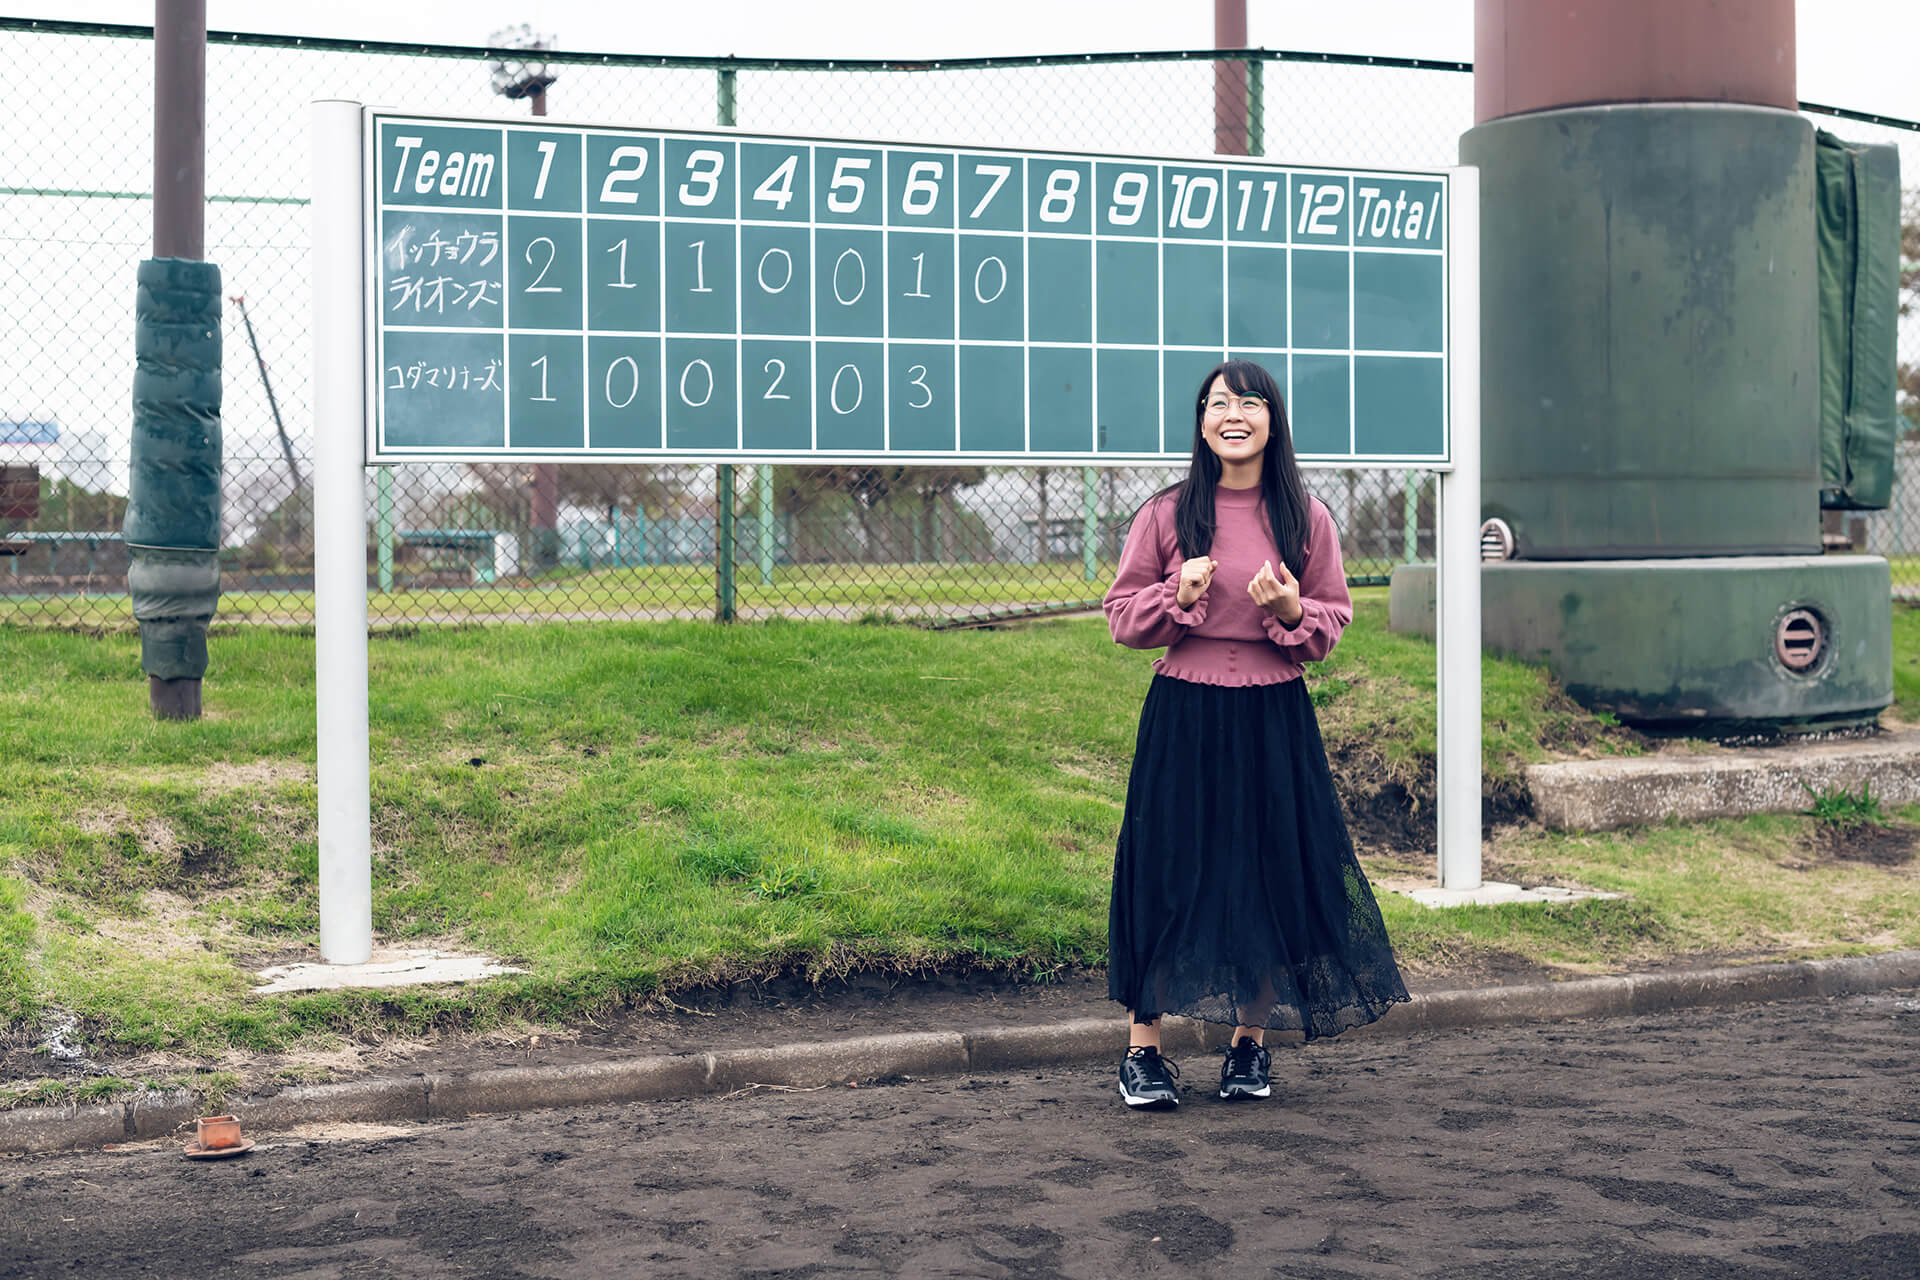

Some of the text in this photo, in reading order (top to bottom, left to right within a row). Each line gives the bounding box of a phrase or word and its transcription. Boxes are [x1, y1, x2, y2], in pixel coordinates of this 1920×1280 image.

[392, 135, 1441, 242] Team 1 2 3 4 5 6 7 8 9 10 11 12 Total
[389, 275, 502, 314] ライオンズ
[524, 236, 1007, 306] 2 1 1 0 0 1 0
[387, 358, 503, 392] コダマリナーズ
[529, 355, 933, 415] 1 0 0 2 0 3
